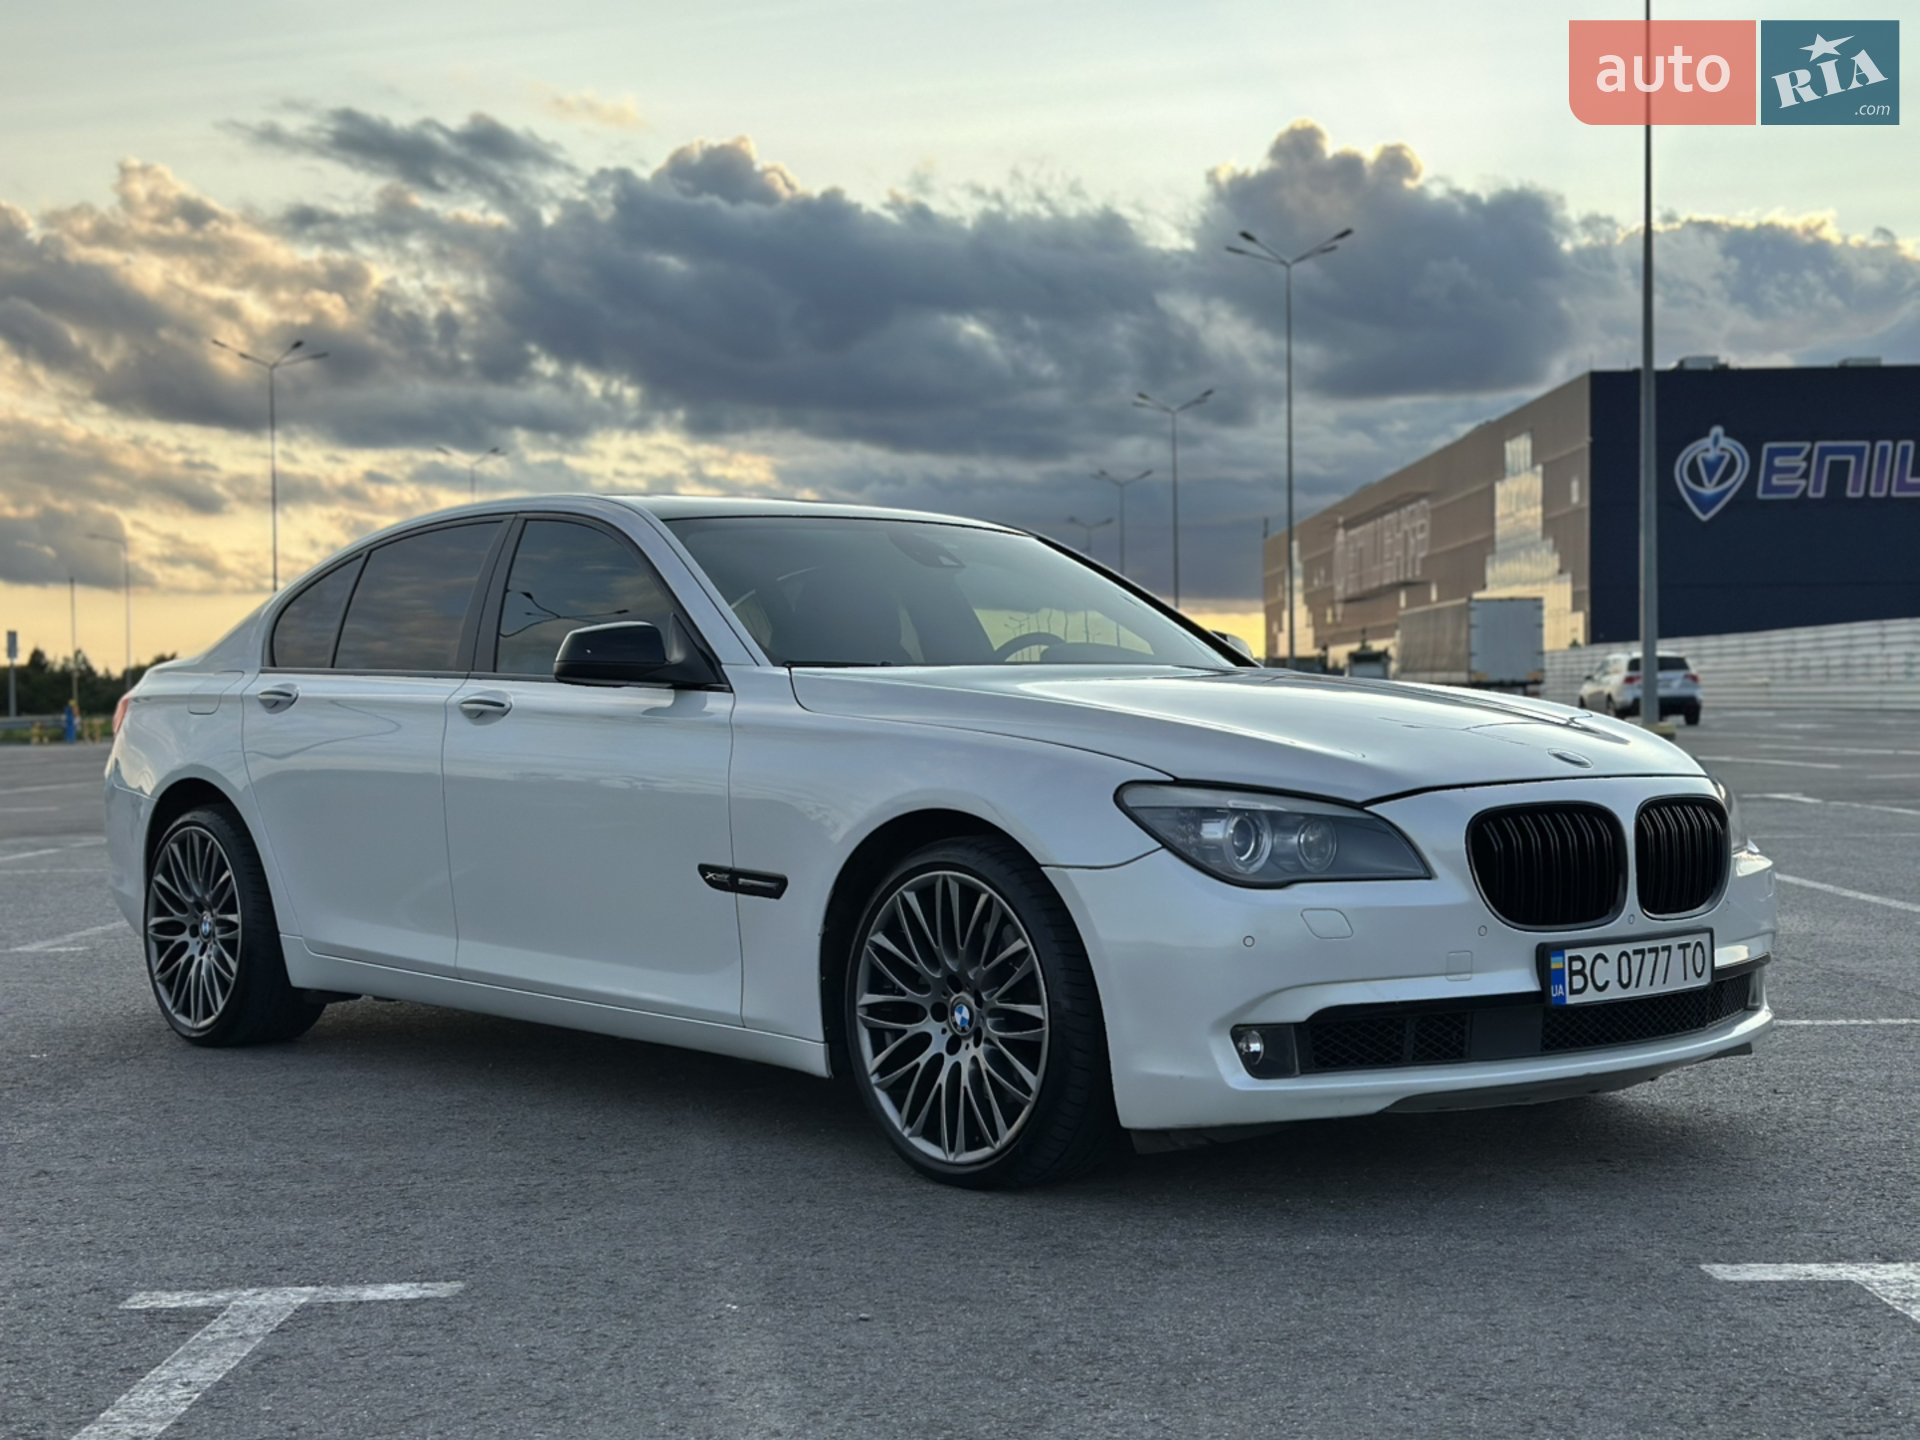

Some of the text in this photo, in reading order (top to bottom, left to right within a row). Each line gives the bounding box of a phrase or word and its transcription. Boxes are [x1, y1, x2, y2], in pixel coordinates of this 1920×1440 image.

[1568, 941, 1706, 996] BC 0777 TO
[1551, 985, 1565, 997] UA
